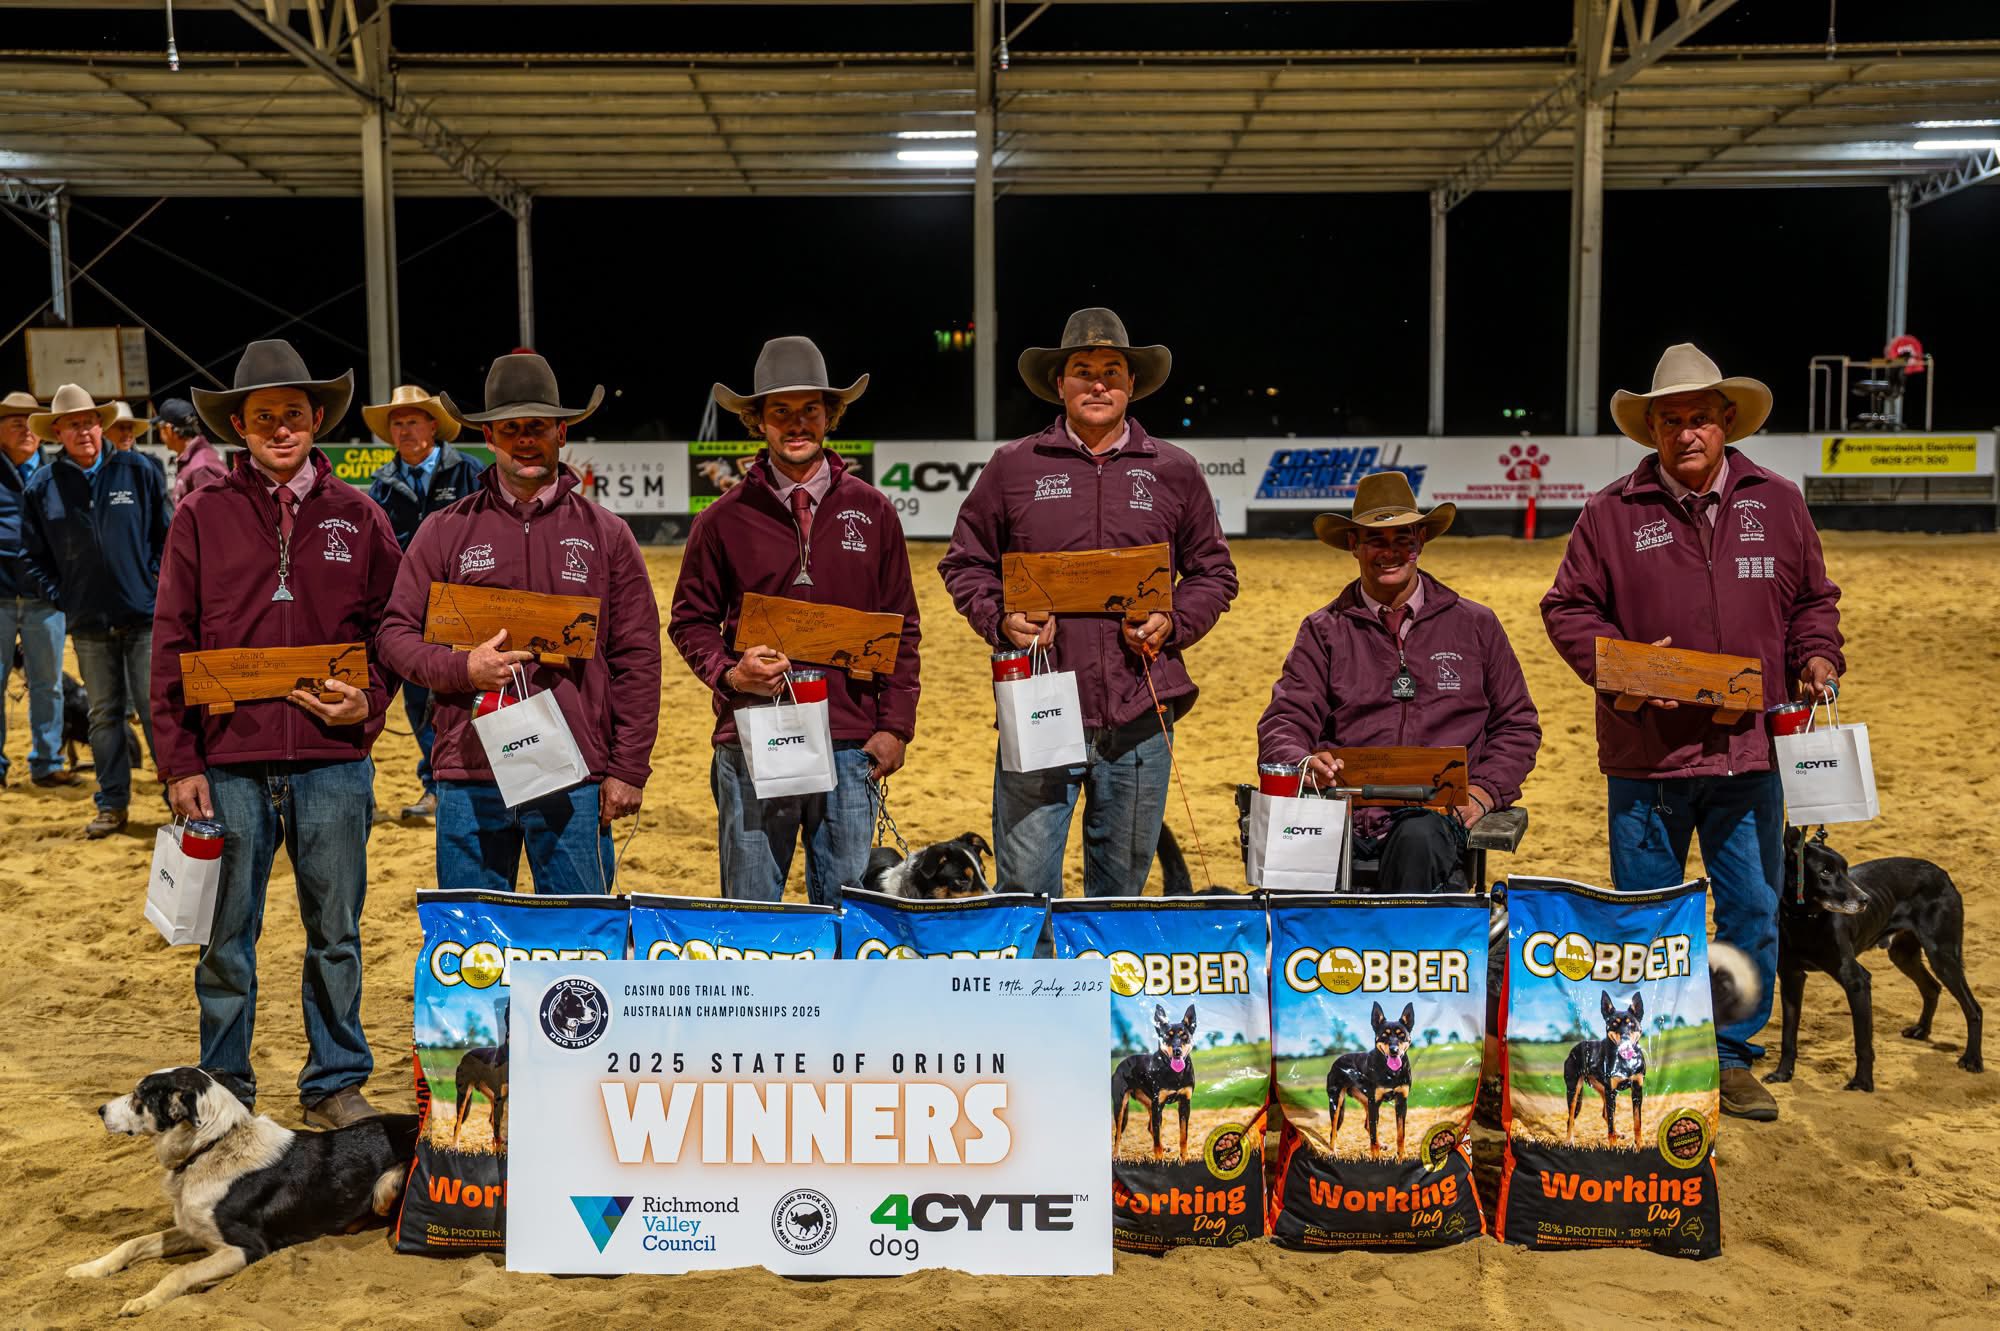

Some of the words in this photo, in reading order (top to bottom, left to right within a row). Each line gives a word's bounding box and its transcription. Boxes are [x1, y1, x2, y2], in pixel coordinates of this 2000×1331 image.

[1268, 446, 1380, 468] CASINO
[592, 462, 665, 473] CASINO
[593, 475, 664, 497] RSM
[1035, 487, 1072, 498] AWSDM
[1635, 532, 1673, 549] AWSDM
[1031, 707, 1062, 720] 4CYTE
[502, 734, 540, 753] 4CYTE
[767, 735, 805, 746] 4CYTE
[1795, 759, 1838, 769] 4CYTE
[1283, 826, 1322, 836] 4CYTE
[1522, 931, 1690, 984] COBBER
[473, 973, 489, 981] 1985
[1284, 946, 1469, 994] COBBER
[1566, 964, 1581, 974] 1985
[556, 981, 594, 990] CASINO
[624, 985, 665, 996] CASINO
[670, 985, 690, 996] DOG
[695, 985, 726, 996] TRIAL
[732, 985, 754, 996] INC.
[952, 977, 991, 991] DATE
[999, 979, 1024, 995] 19th
[1031, 978, 1065, 997] July
[1072, 981, 1104, 992] 2025
[623, 1005, 691, 1017] AUSTRALIAN
[697, 1005, 787, 1017] CHAMPIONSHIPS
[792, 1005, 820, 1017] 2025
[549, 1032, 568, 1046] DOG
[572, 1033, 600, 1047] TRIAL
[607, 1052, 685, 1074] 2025
[711, 1052, 806, 1074] STATE
[833, 1052, 866, 1074] OF
[892, 1052, 1006, 1074] ORIGIN
[599, 1082, 1012, 1164] WINNERS
[1309, 1174, 1458, 1212] Working
[1540, 1169, 1703, 1207] Working
[642, 1196, 739, 1213] Richmond
[796, 1193, 822, 1204] STOCK
[776, 1195, 796, 1228] WORKING
[821, 1203, 831, 1219] DOG
[870, 1192, 1074, 1232] 4CYTE
[1411, 1209, 1443, 1229] Dog
[1647, 1203, 1681, 1228] Dog
[426, 1223, 449, 1236] 28%
[451, 1227, 501, 1238] PROTEIN
[642, 1215, 701, 1236] Valley
[1193, 1215, 1227, 1236] Dog
[1304, 1224, 1328, 1237] 28%
[1330, 1231, 1381, 1239] PROTEIN
[1393, 1231, 1415, 1239] 18%
[1417, 1229, 1437, 1238] FAT
[1537, 1221, 1563, 1234] 28%
[1565, 1226, 1617, 1237] PROTEIN
[1628, 1228, 1651, 1237] 18%
[1653, 1227, 1672, 1237] FAT
[642, 1235, 716, 1251] Council
[778, 1229, 791, 1244] NSW
[795, 1220, 832, 1250] ASSOCIATION
[1115, 1227, 1164, 1243] PROTEIN
[1175, 1236, 1197, 1245] 18%
[1199, 1236, 1219, 1246] FAT
[869, 1234, 919, 1260] dog
